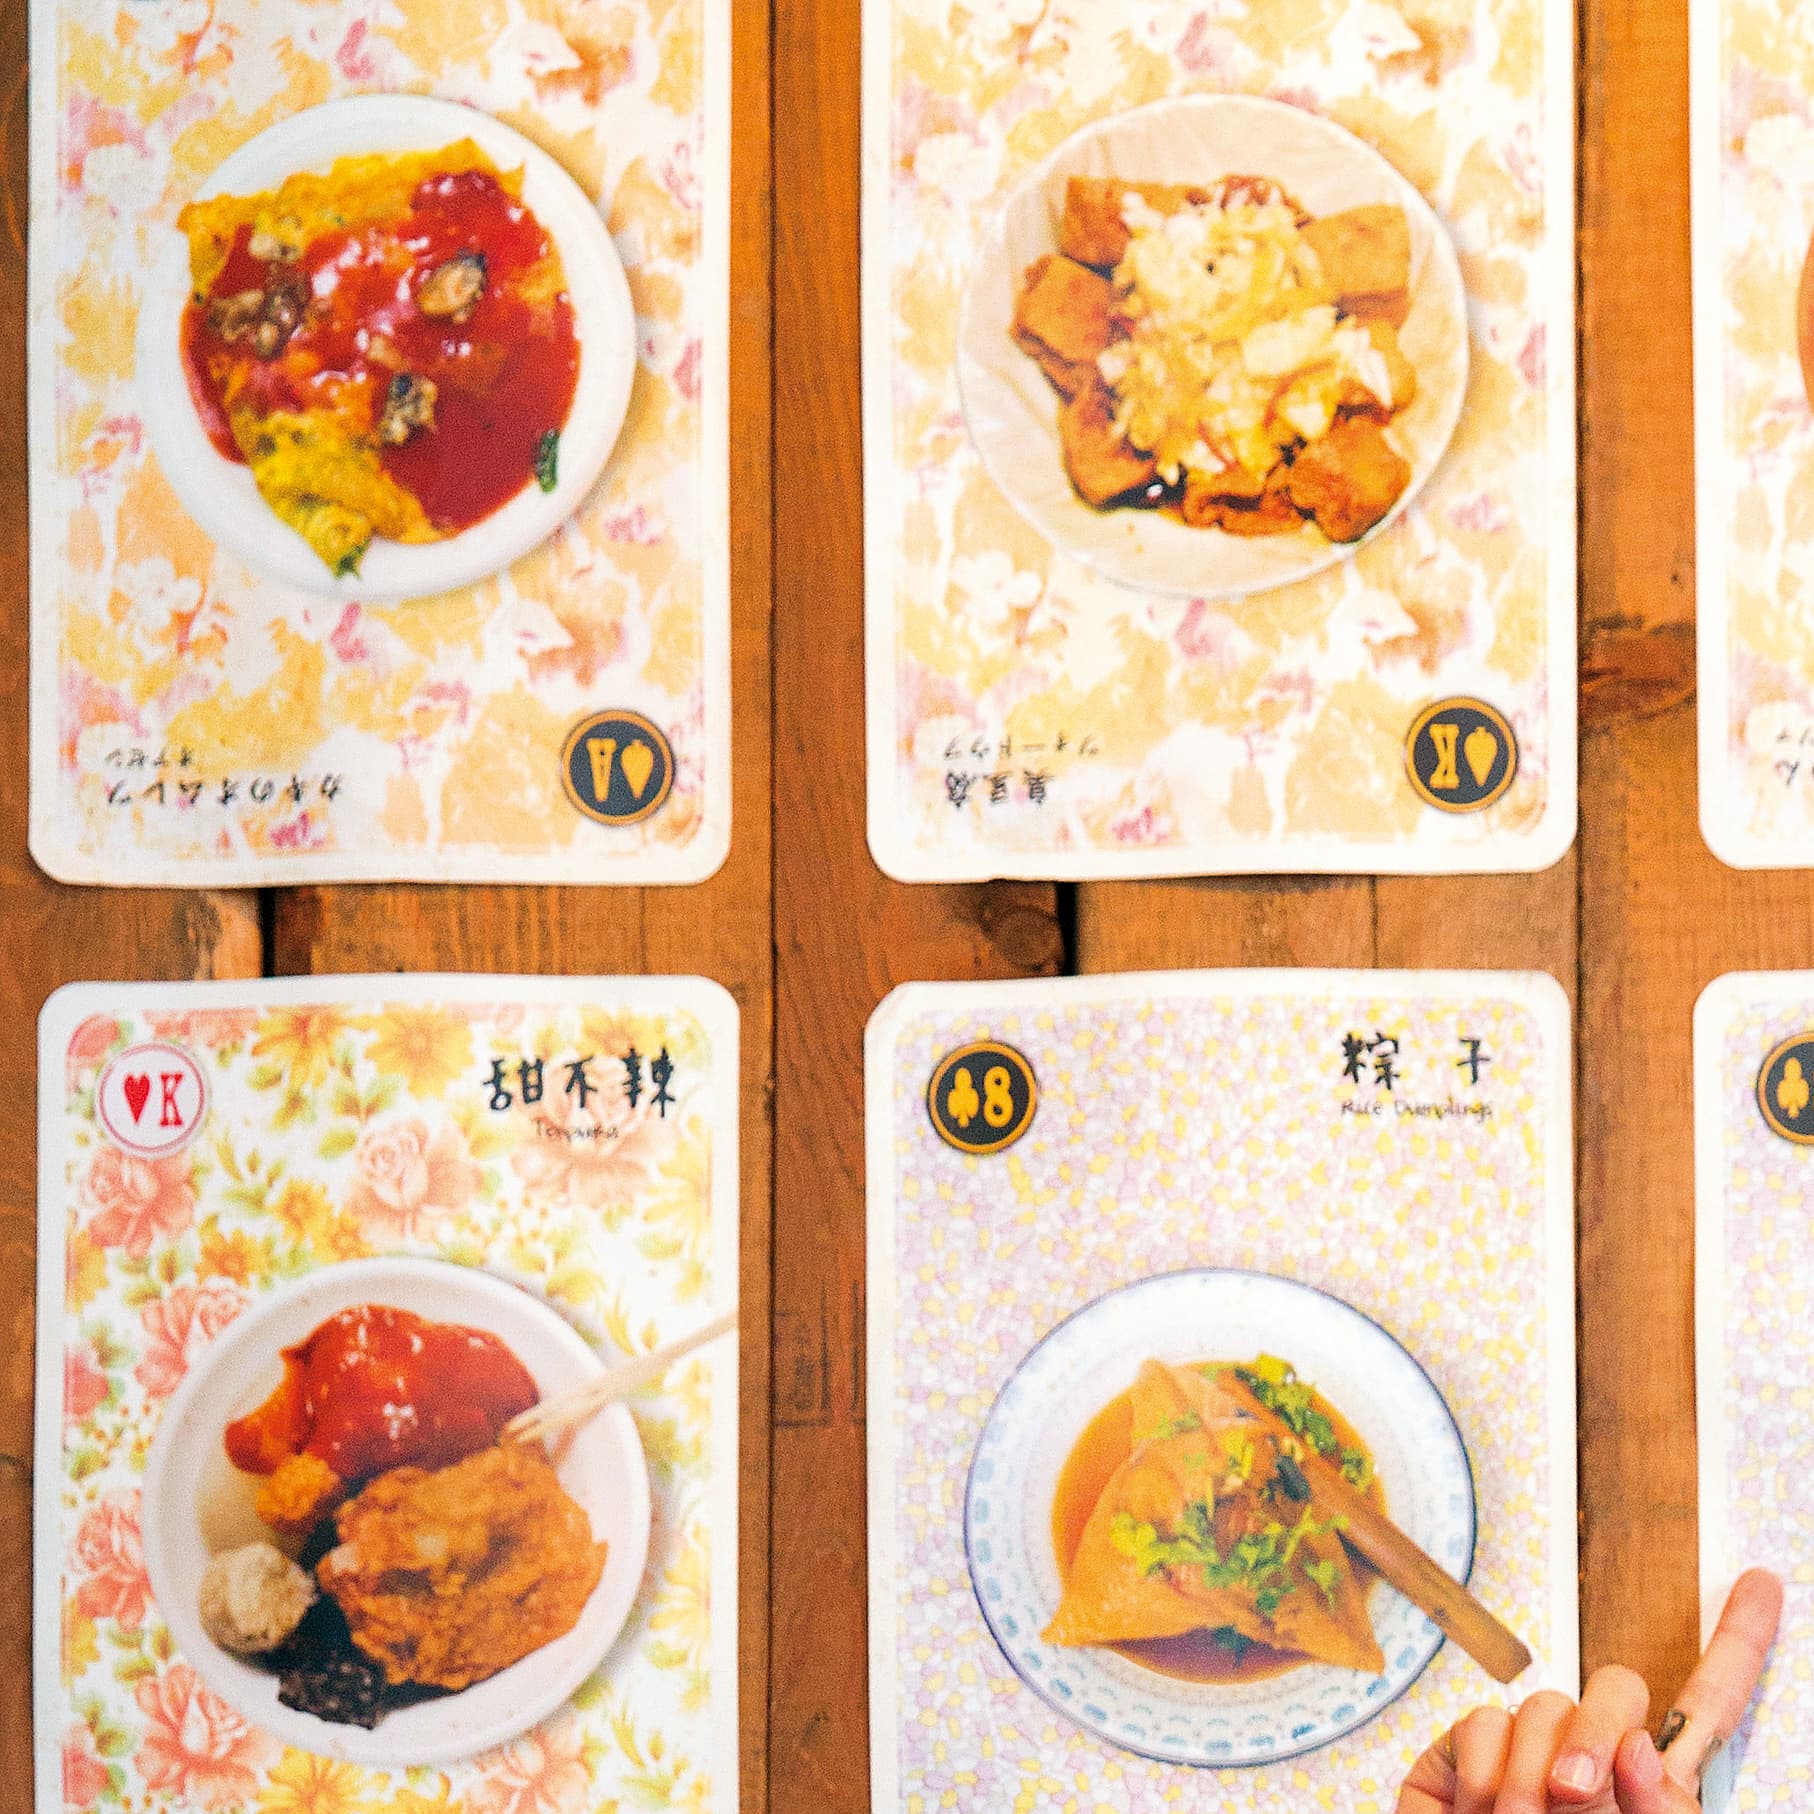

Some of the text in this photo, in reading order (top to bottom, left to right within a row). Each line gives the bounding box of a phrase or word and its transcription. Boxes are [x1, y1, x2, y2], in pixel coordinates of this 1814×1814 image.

[586, 739, 617, 802] A
[1430, 725, 1460, 790] K
[160, 1072, 185, 1128] K
[483, 1045, 677, 1118] 甜不辣
[982, 1065, 1013, 1128] 8
